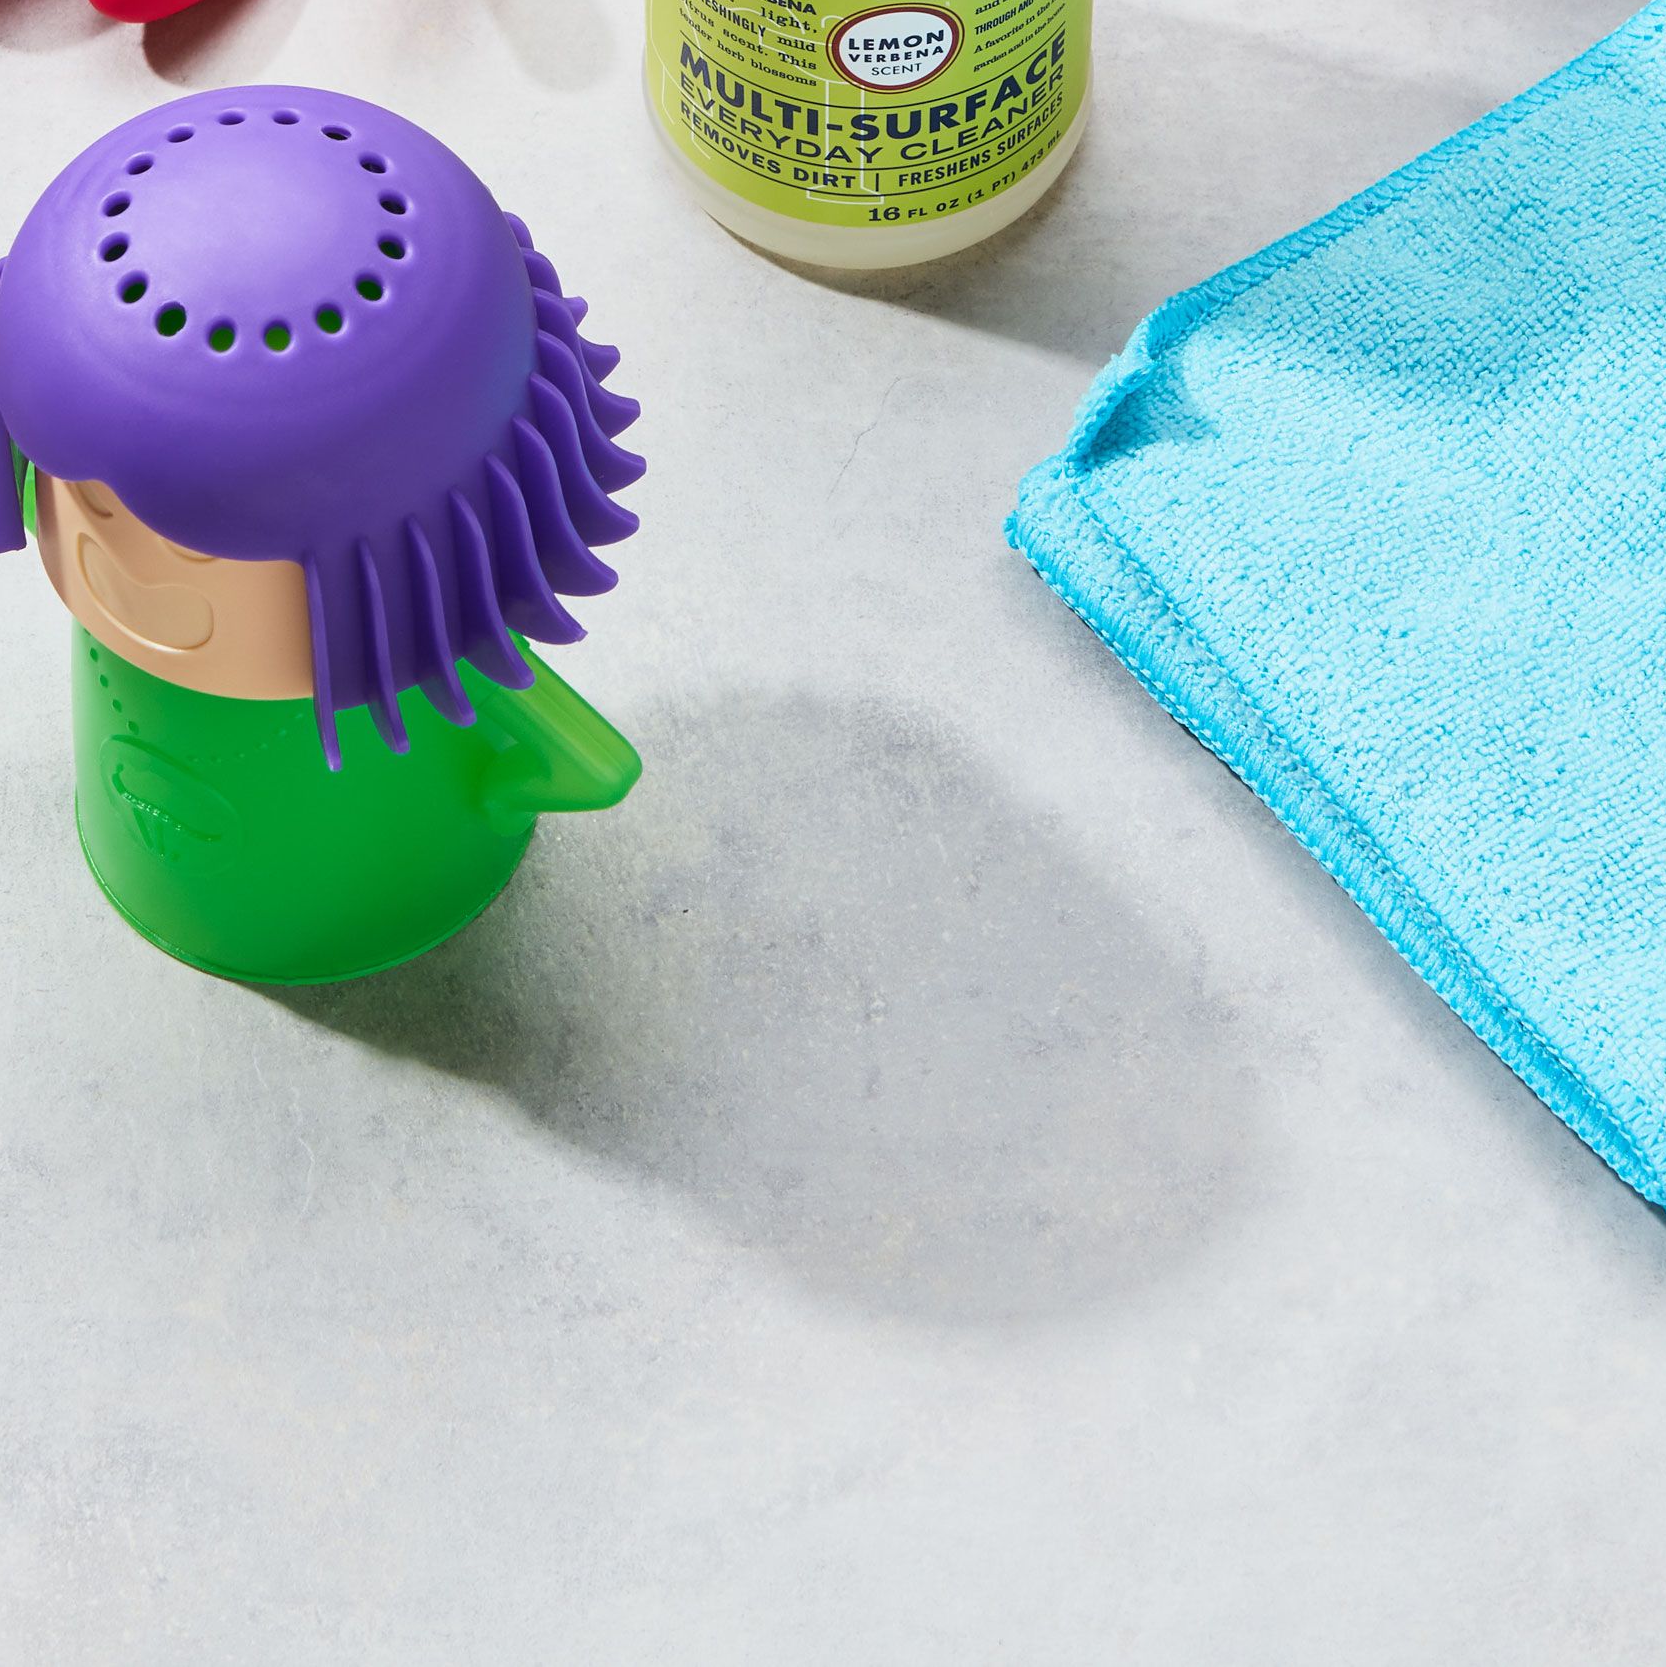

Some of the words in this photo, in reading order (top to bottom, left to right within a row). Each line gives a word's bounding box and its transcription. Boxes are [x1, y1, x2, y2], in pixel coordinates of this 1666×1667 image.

[679, 7, 713, 41] tender
[717, 38, 745, 62] herb
[751, 58, 818, 87] blossoms
[777, 35, 817, 53] mild
[848, 29, 944, 51] LEMON
[973, 44, 983, 54] A
[985, 23, 1025, 49] favorite
[1025, 14, 1035, 26] in
[1036, 0, 1051, 17] the
[973, 51, 1007, 73] garden
[1008, 38, 1025, 54] and
[1025, 32, 1035, 43] in
[1034, 21, 1048, 35] the
[974, 7, 1017, 35] THROUGH
[722, 28, 769, 57] scent.
[777, 51, 817, 70] This
[848, 45, 944, 63] VERBENA
[871, 63, 923, 76] SCENT
[680, 29, 1066, 141] MULTI-SURFACE
[681, 70, 883, 164] EVERYDAY
[900, 63, 1064, 161] CLEANER
[681, 100, 781, 174] REMOVES
[793, 167, 856, 189] DIRT
[898, 149, 991, 187] FRESHENS
[997, 91, 1063, 157] SURFACES
[868, 206, 901, 222] 16
[908, 207, 928, 219] FL
[936, 198, 960, 212] OZ
[967, 189, 985, 204] (1
[991, 171, 1016, 192] PT)
[1021, 148, 1044, 172] 473
